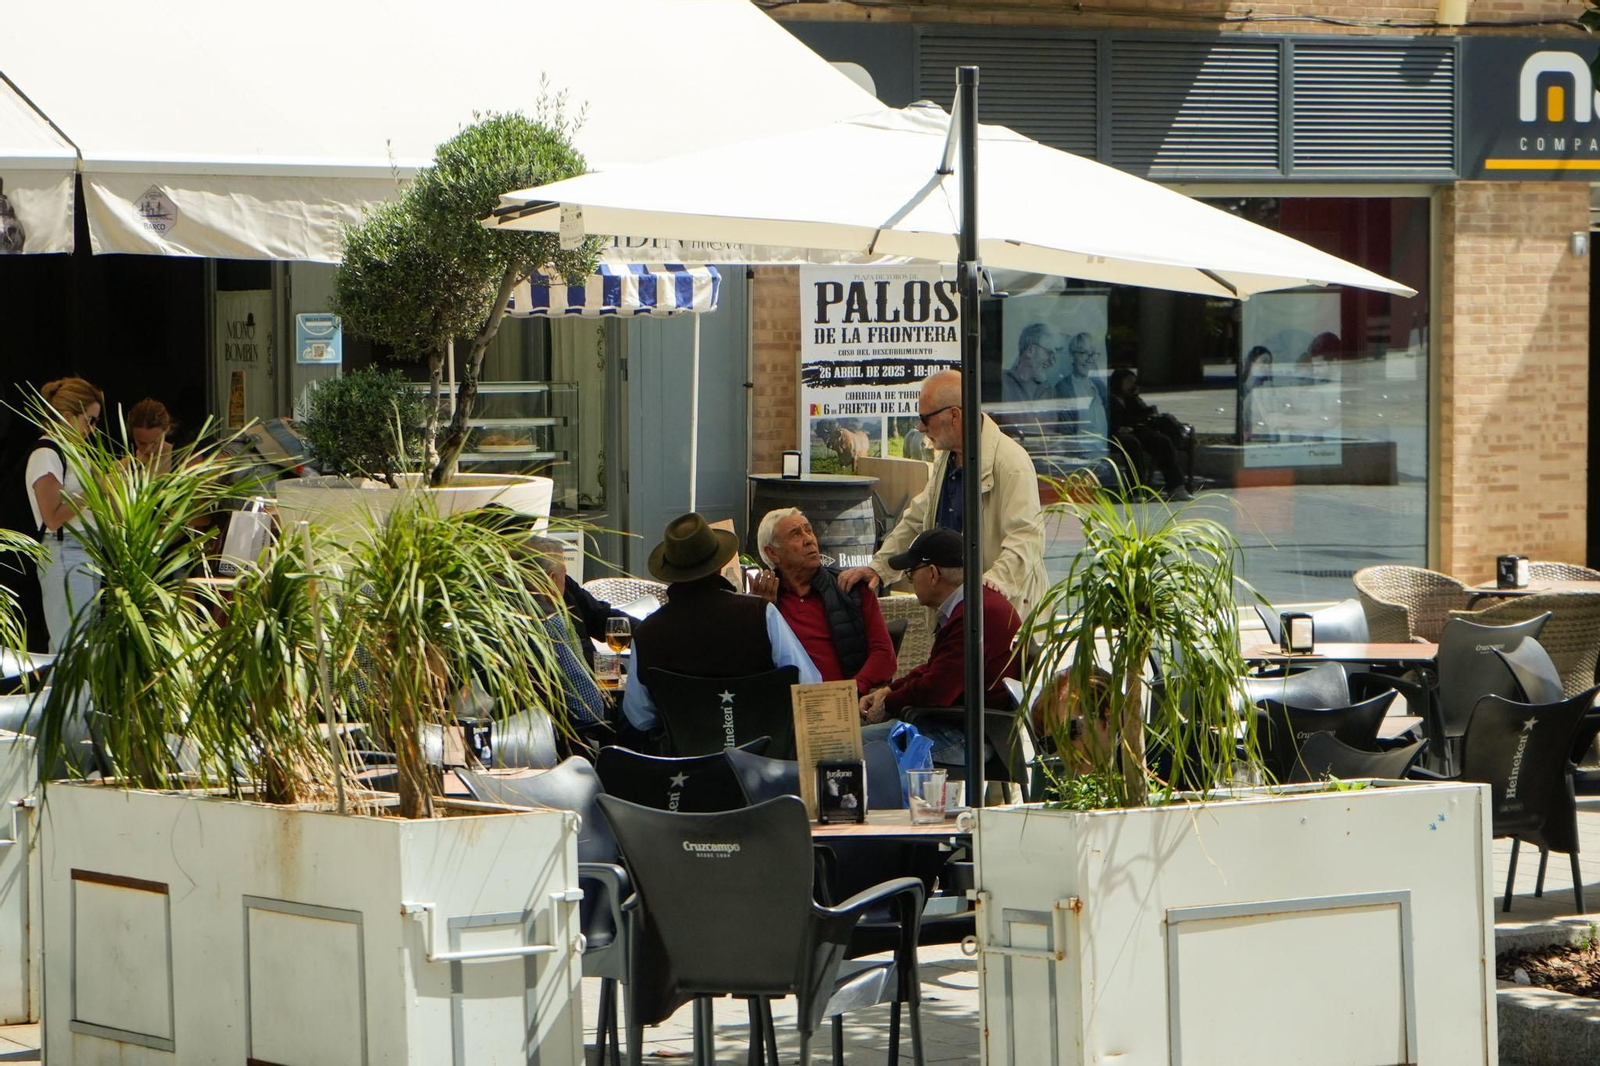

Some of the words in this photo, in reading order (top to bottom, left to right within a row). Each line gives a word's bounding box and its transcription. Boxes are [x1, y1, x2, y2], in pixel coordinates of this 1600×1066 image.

[1520, 137, 1599, 151] COMPA
[814, 280, 959, 324] PALOS
[814, 327, 836, 344] DE
[841, 327, 862, 344] LA
[867, 325, 957, 343] FRONTERA
[872, 348, 933, 356] DESCUBRIMIENTO
[820, 366, 831, 379] 26
[834, 365, 863, 378] ABRIL
[866, 365, 880, 378] DE
[882, 365, 905, 377] 2025
[913, 364, 940, 377] 18:00
[845, 390, 882, 401] CORRIDA
[884, 390, 896, 400] DE
[823, 403, 830, 415] 6
[838, 402, 877, 415] PRIETO
[880, 402, 895, 414] DE
[898, 402, 911, 413] LA
[720, 706, 735, 749] ineken
[1506, 734, 1529, 799] Heineken
[683, 841, 740, 853] Cruzcampo
